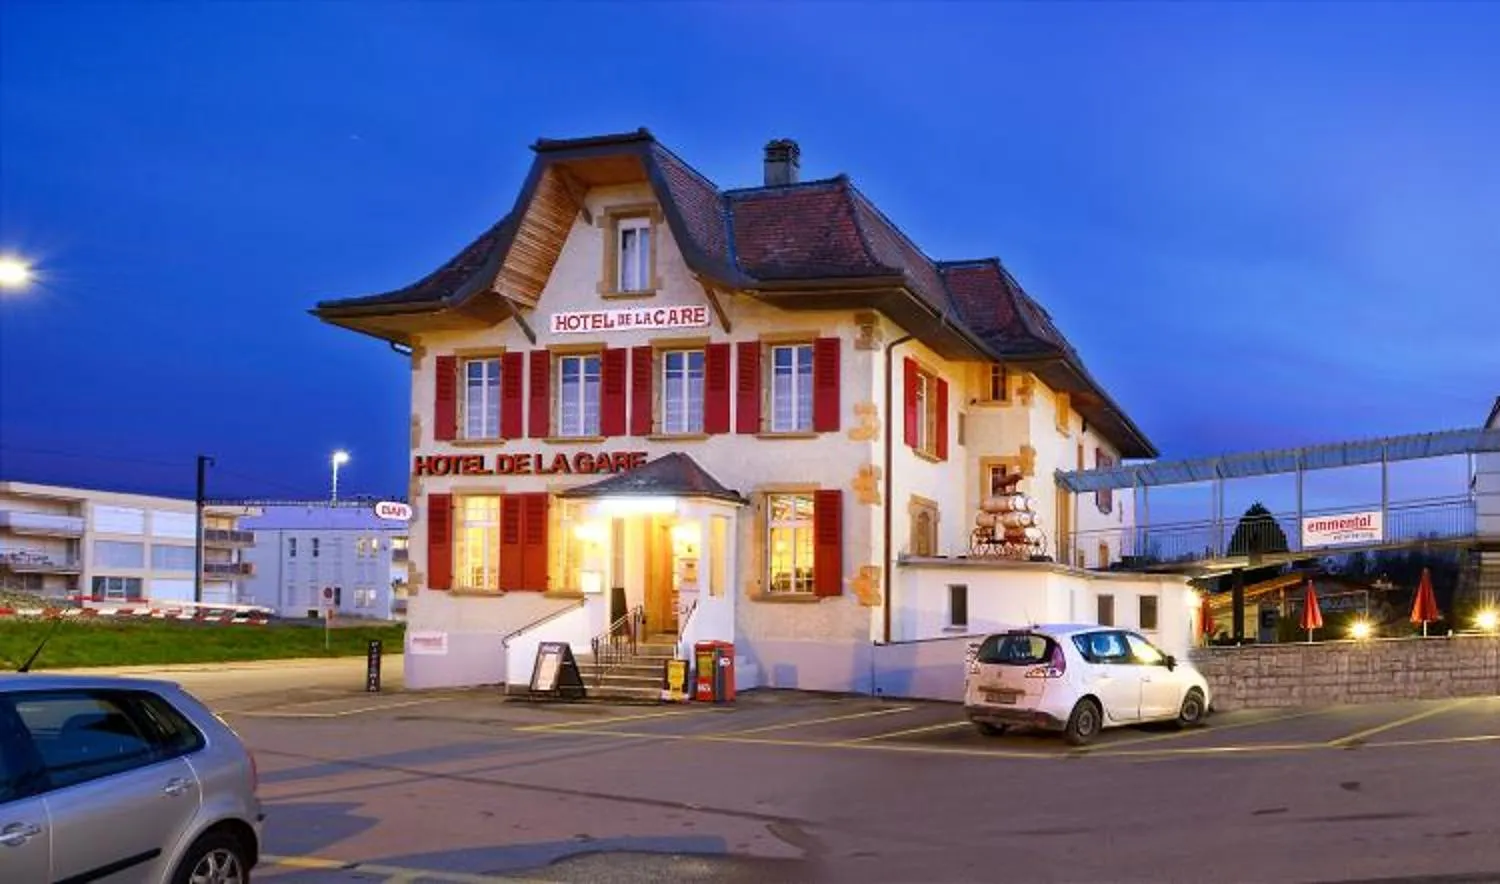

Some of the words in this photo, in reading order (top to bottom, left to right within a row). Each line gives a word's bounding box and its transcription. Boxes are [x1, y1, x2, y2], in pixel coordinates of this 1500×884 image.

[556, 314, 614, 331] HOTEL
[617, 313, 631, 326] DE
[635, 312, 651, 325] LA
[414, 454, 493, 476] HOTEL
[496, 453, 531, 475] DE
[535, 452, 571, 474] LA
[573, 451, 649, 474] GARE
[1307, 513, 1371, 533] emmental
